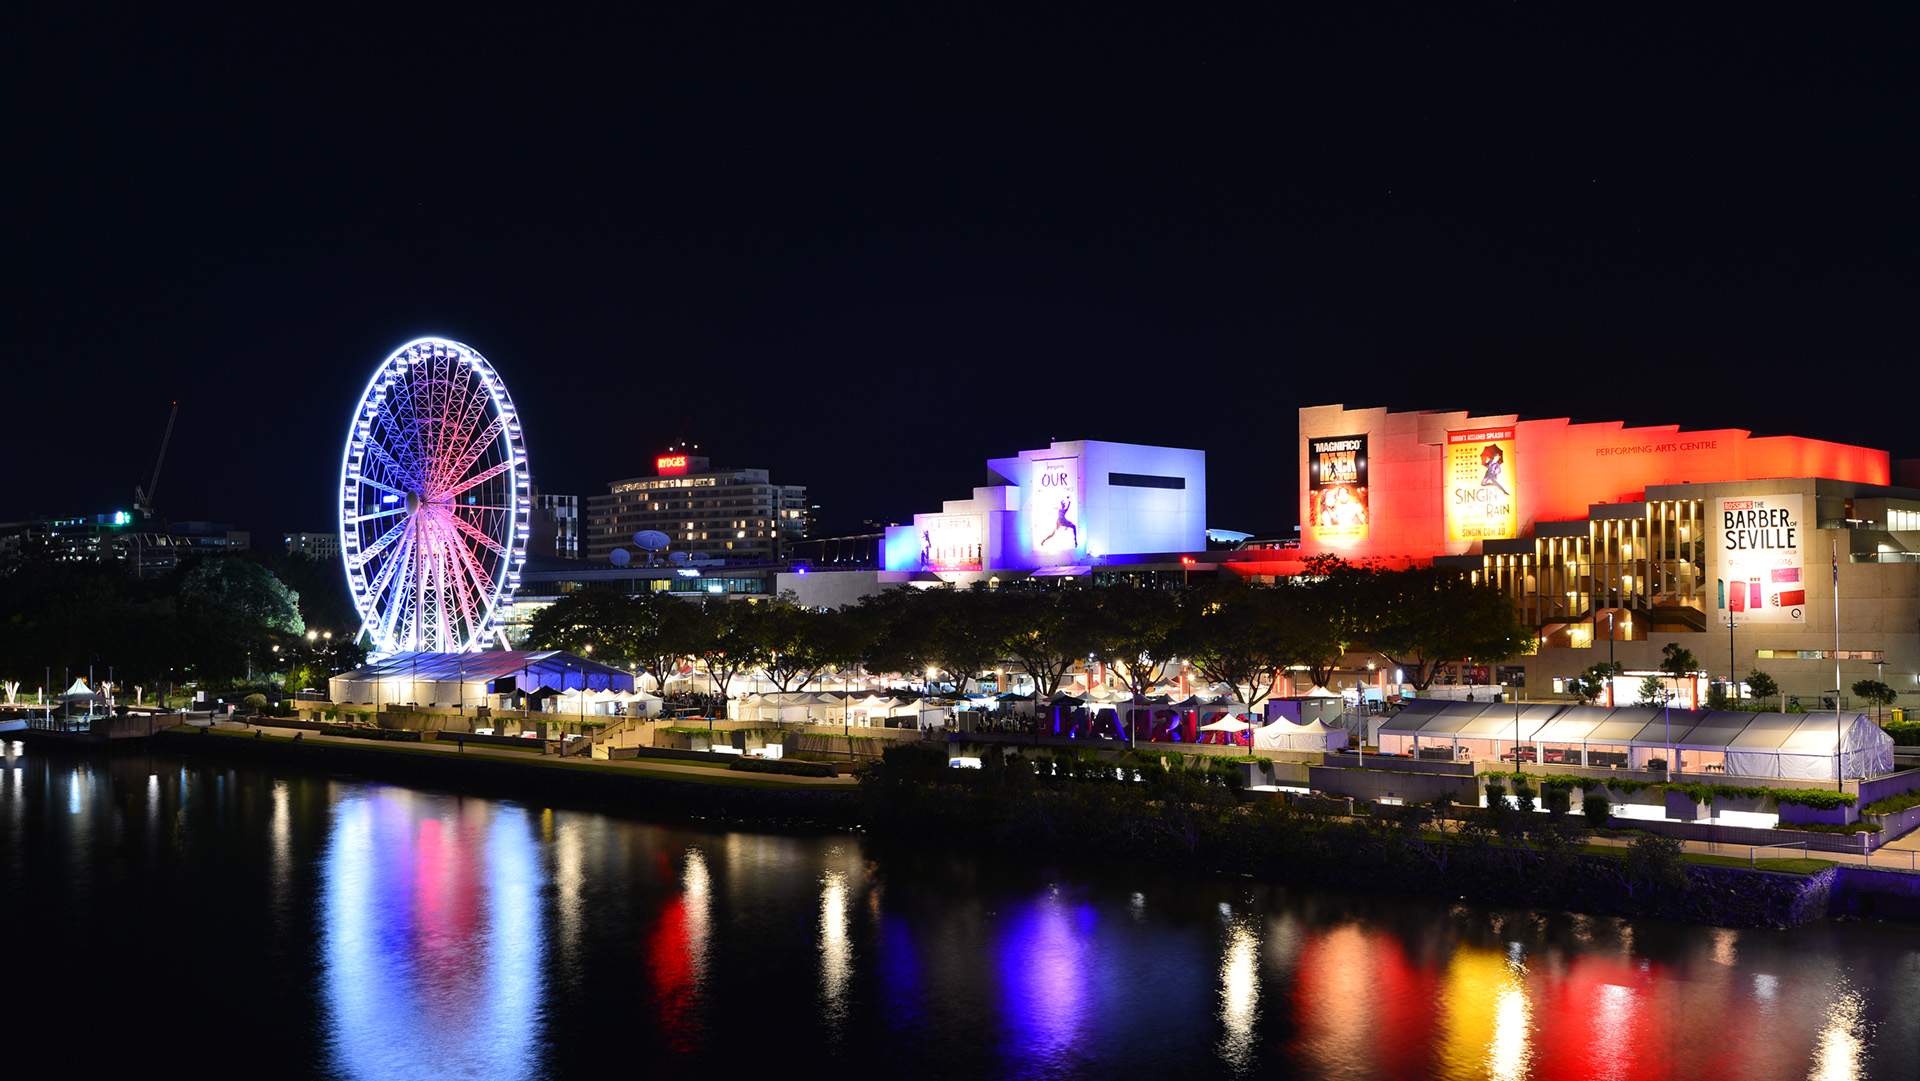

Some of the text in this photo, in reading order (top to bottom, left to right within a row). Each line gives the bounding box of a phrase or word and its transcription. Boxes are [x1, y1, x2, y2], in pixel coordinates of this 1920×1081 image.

[1595, 440, 1717, 456] PERFORMING ARTS CENTRE
[658, 457, 685, 468] RYDGES
[1041, 472, 1068, 487] OUR
[1486, 503, 1510, 519] RAIN
[1754, 501, 1764, 509] THE
[1724, 508, 1790, 529] BARBER
[1725, 527, 1797, 550] SEVILLE
